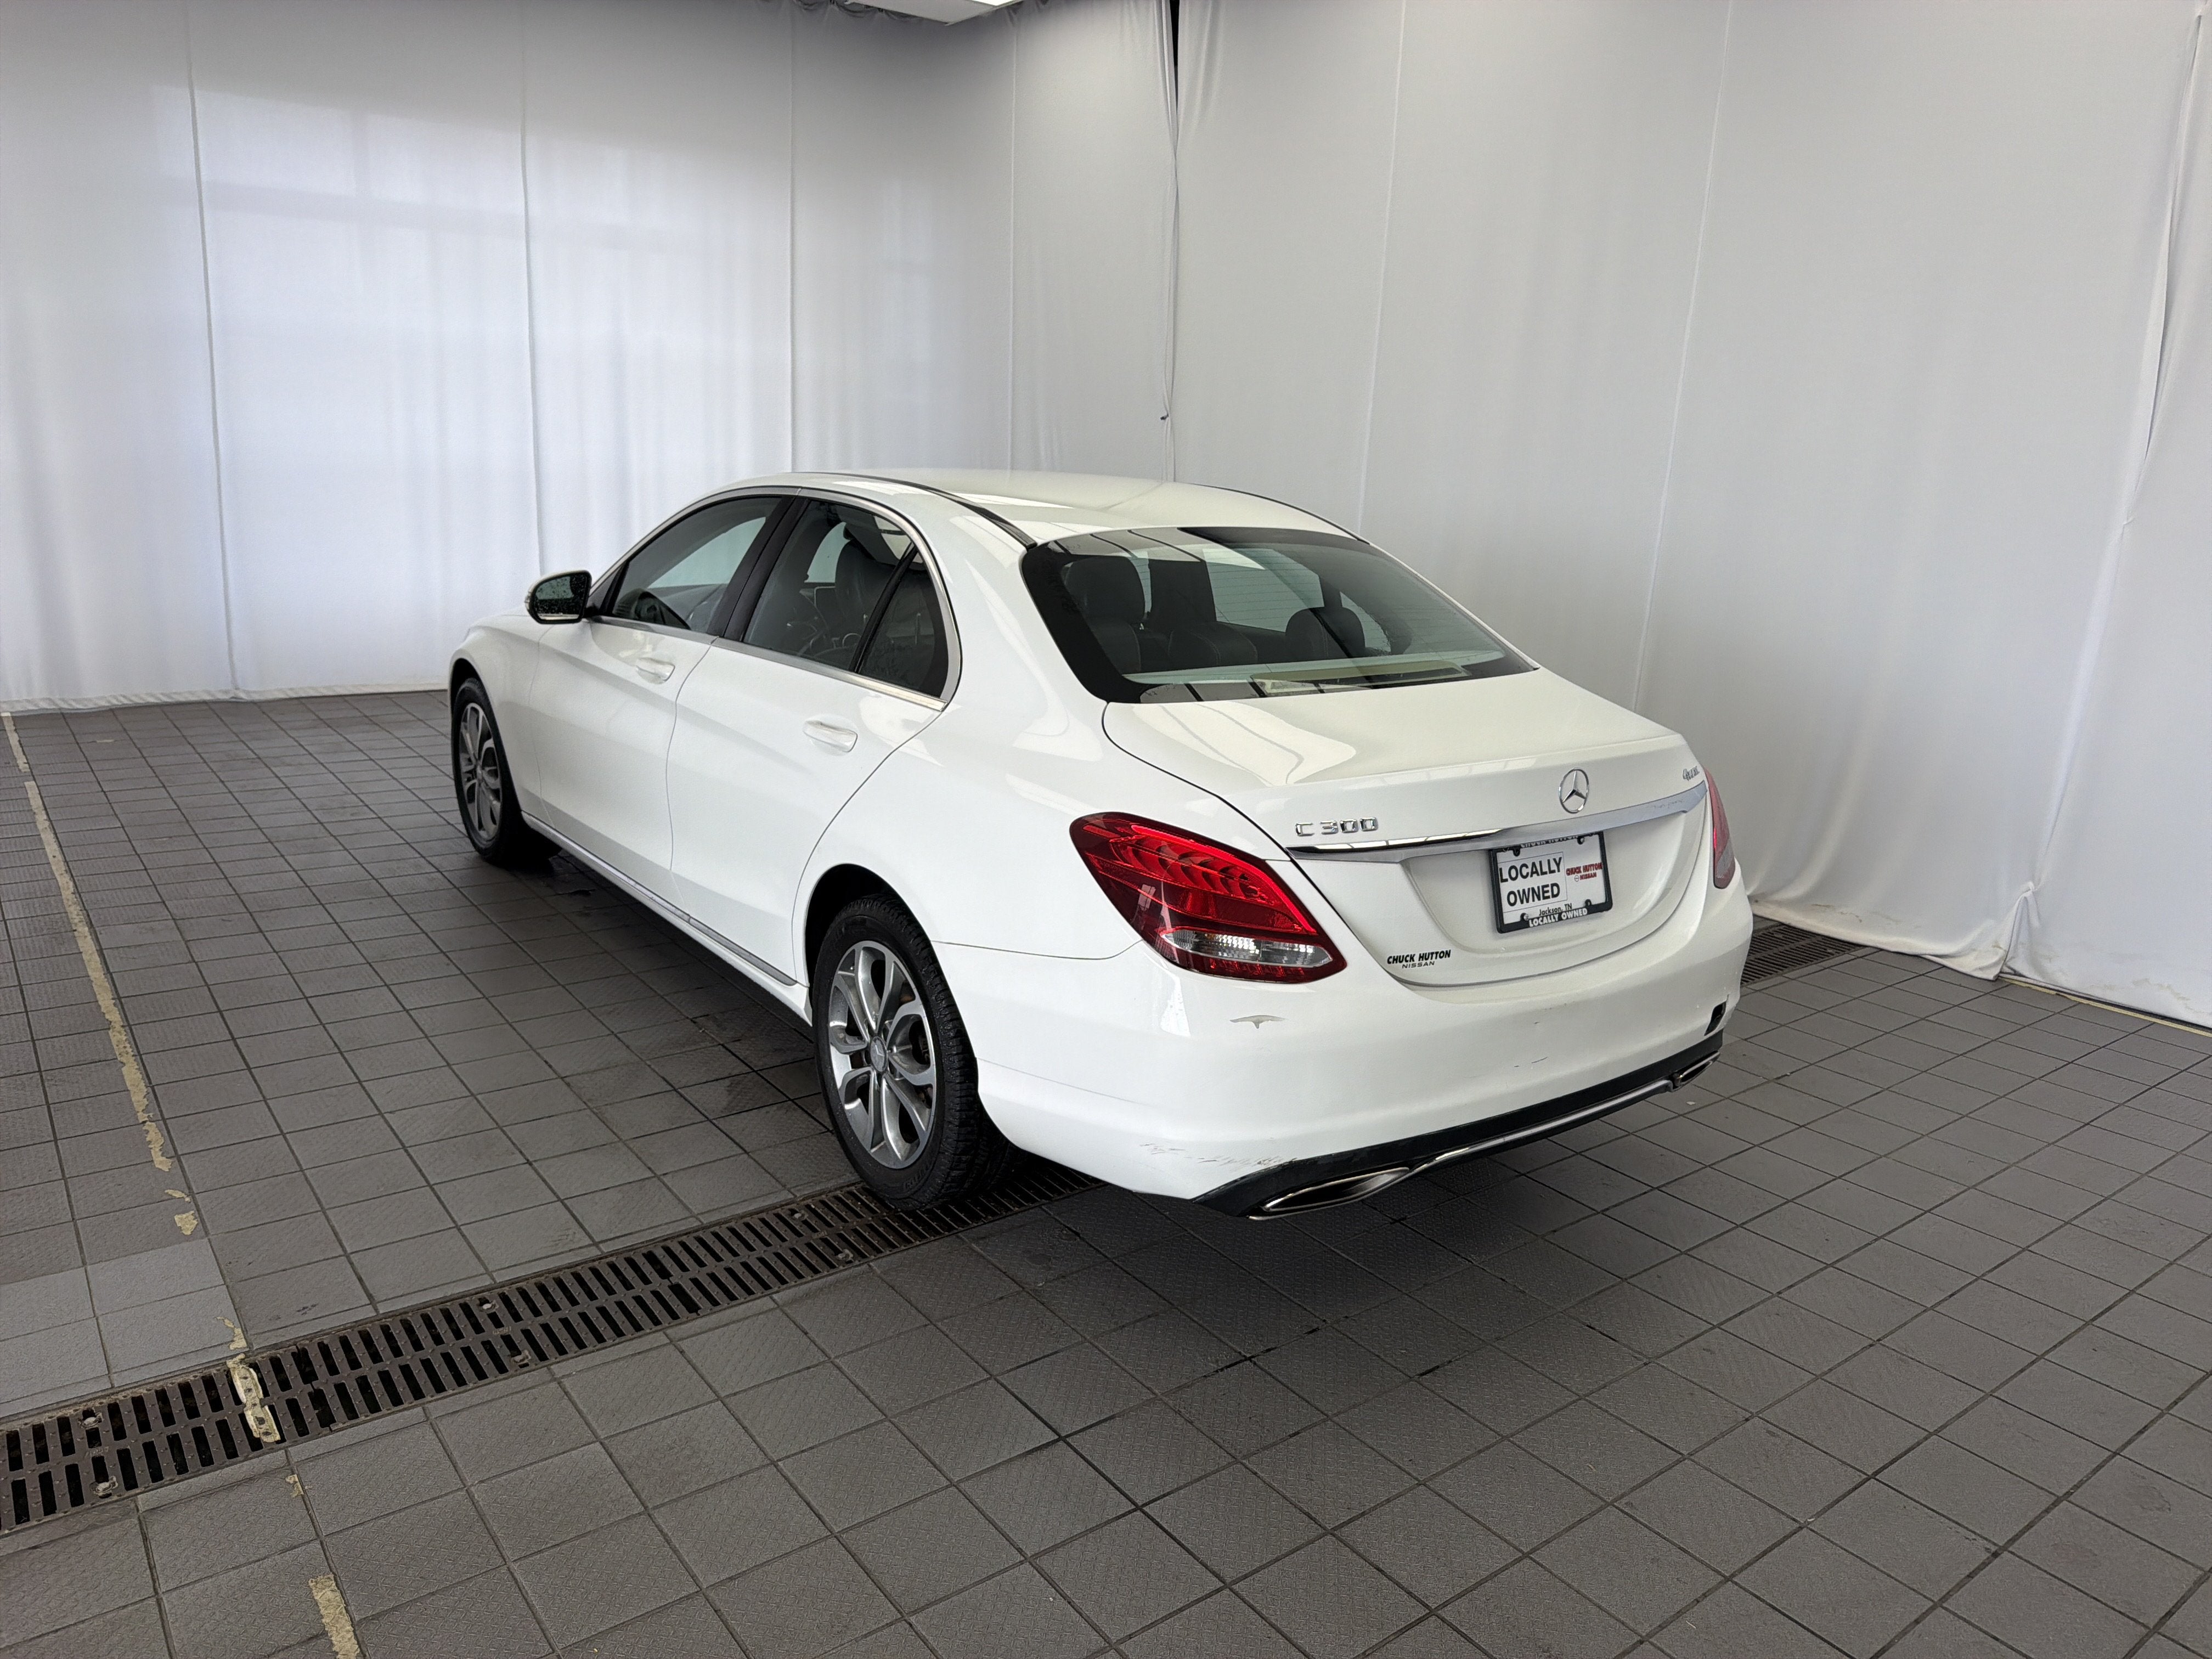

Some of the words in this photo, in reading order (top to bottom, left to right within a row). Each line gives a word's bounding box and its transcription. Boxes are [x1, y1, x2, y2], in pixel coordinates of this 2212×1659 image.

[1295, 822, 1314, 837] C
[1320, 817, 1379, 834] 300
[1499, 857, 1562, 883] LOCALLY
[1566, 866, 1582, 876] CHUCK
[1507, 883, 1560, 906] OWNED
[1529, 913, 1559, 927] LOCALLY
[1561, 908, 1588, 920] OWNED
[1539, 907, 1562, 916] Jackson,
[1387, 953, 1415, 964] CHUCK
[1418, 950, 1451, 961] HUTTON
[1402, 961, 1435, 969] NISSAN
